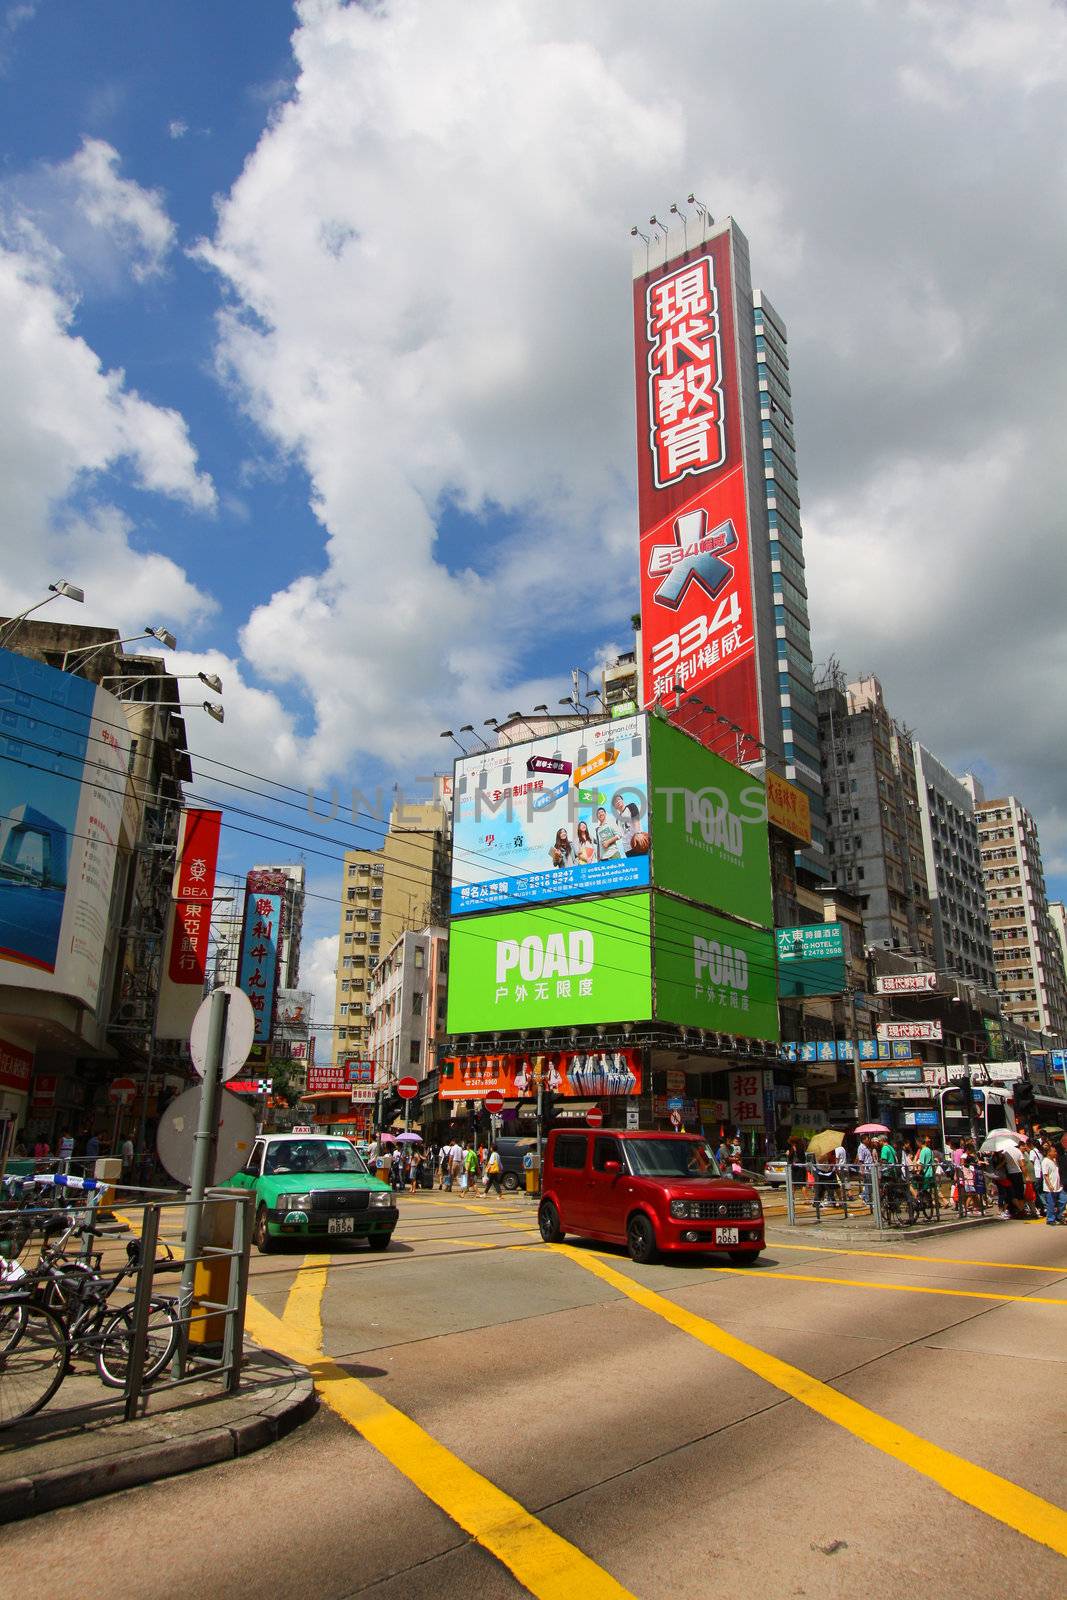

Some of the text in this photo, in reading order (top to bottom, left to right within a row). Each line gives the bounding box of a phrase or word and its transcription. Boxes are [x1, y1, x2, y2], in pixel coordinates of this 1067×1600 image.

[655, 265, 713, 475] 現代教育
[652, 591, 742, 676] 334
[653, 624, 742, 700] 新制權威
[182, 887, 208, 897] BEA
[178, 903, 202, 971] 東亞銀行
[496, 930, 594, 983] POAD
[693, 935, 748, 991] POAD
[809, 940, 833, 949] HOTEL
[887, 1024, 931, 1037] 現代教育
[733, 1075, 761, 1120] 招租
